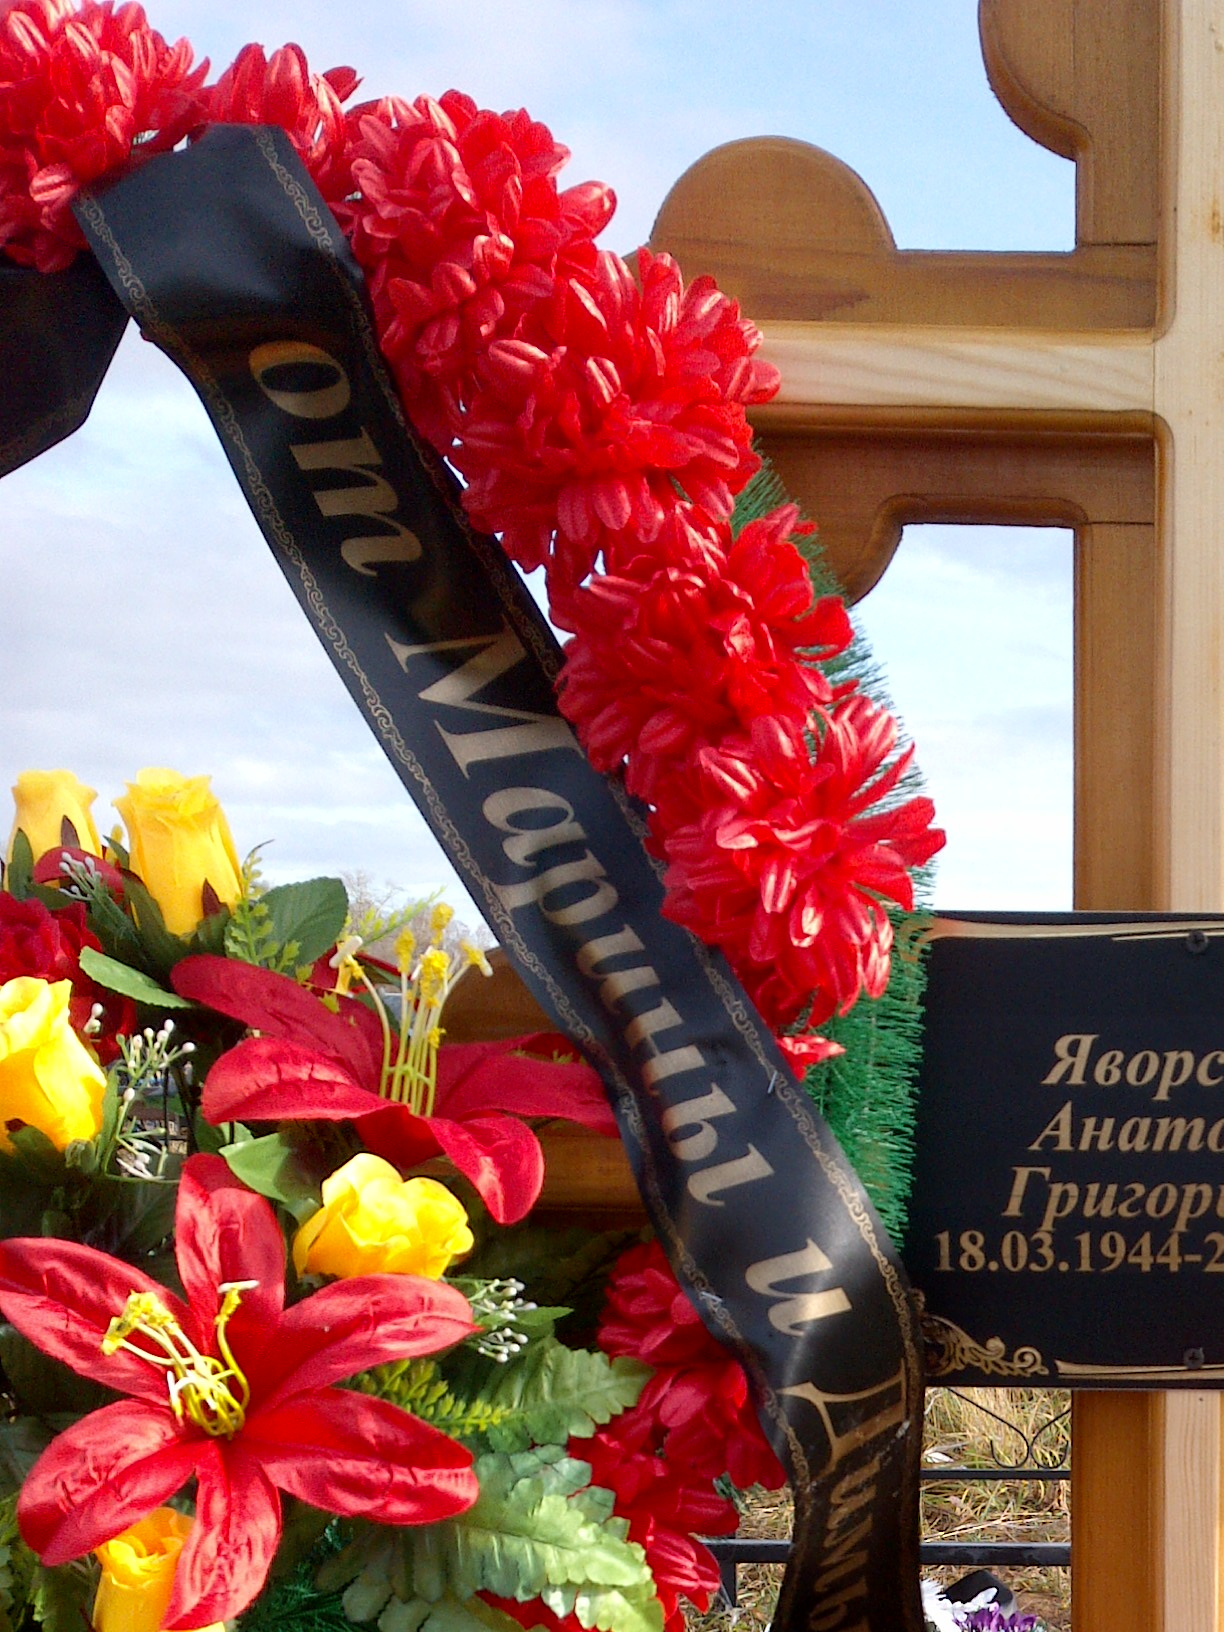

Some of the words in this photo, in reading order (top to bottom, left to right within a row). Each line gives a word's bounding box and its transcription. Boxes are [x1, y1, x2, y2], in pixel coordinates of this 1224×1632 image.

[248, 340, 423, 577] от
[383, 616, 776, 1207] Марины
[744, 1237, 853, 1338] и
